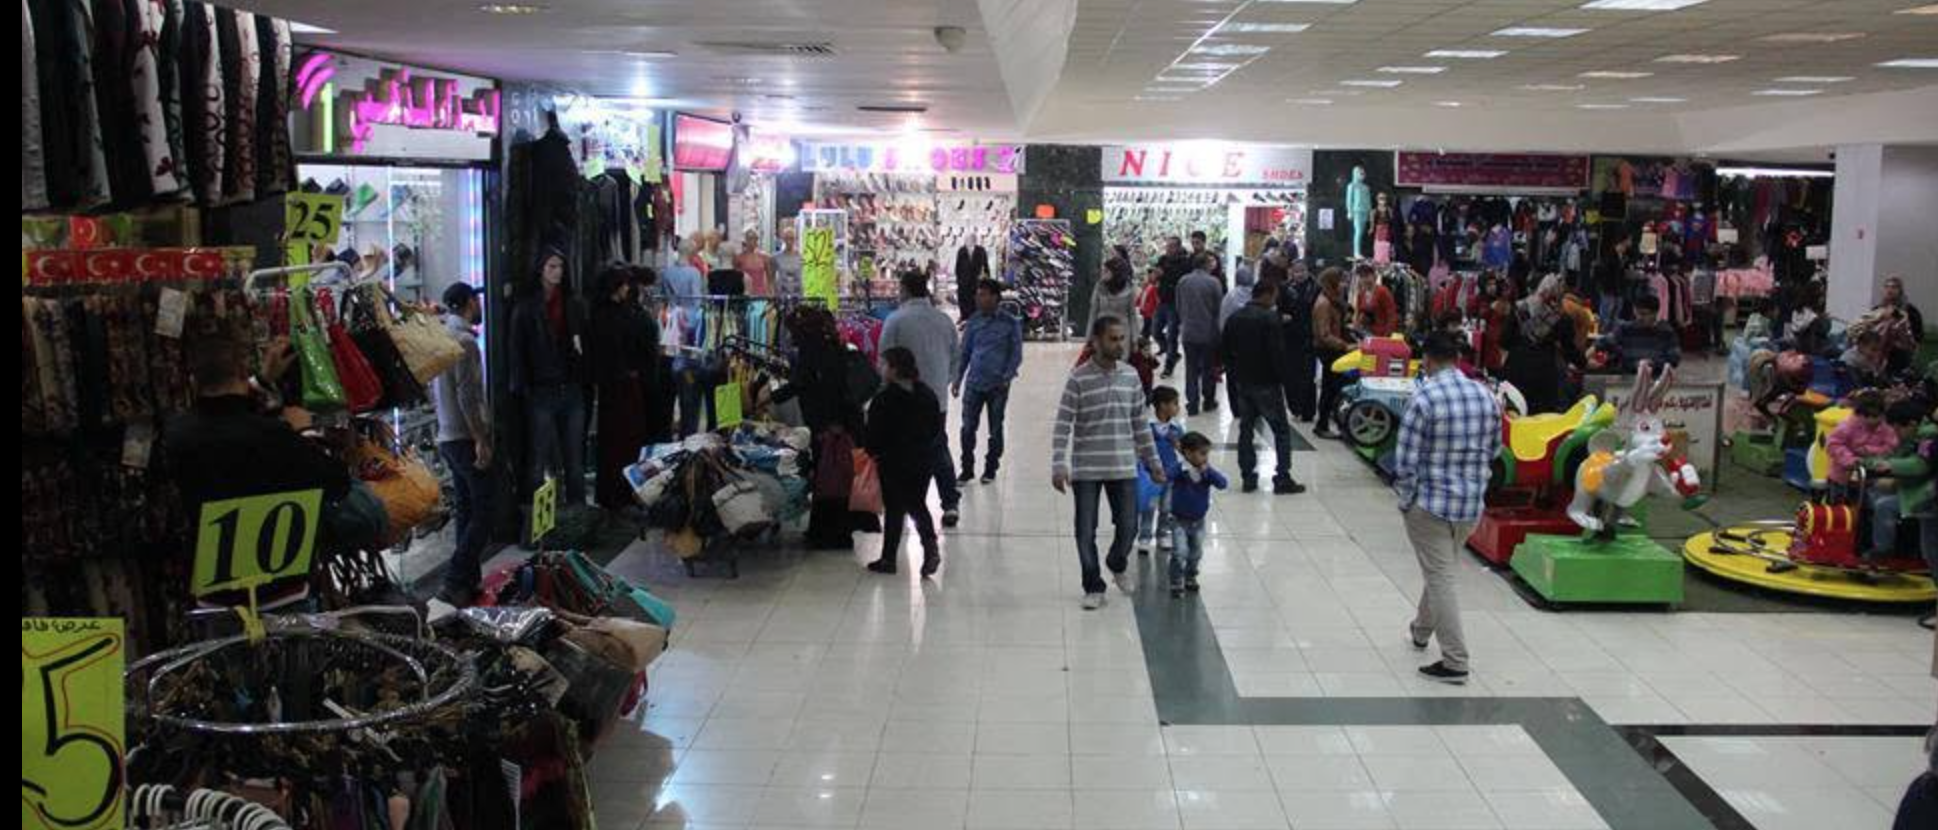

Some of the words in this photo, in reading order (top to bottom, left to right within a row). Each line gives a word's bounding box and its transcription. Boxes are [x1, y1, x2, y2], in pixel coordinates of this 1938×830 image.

[801, 146, 874, 170] LULU
[883, 147, 986, 171] SOES
[1118, 150, 1246, 178] NICE
[291, 201, 332, 240] 25
[203, 501, 307, 588] 10
